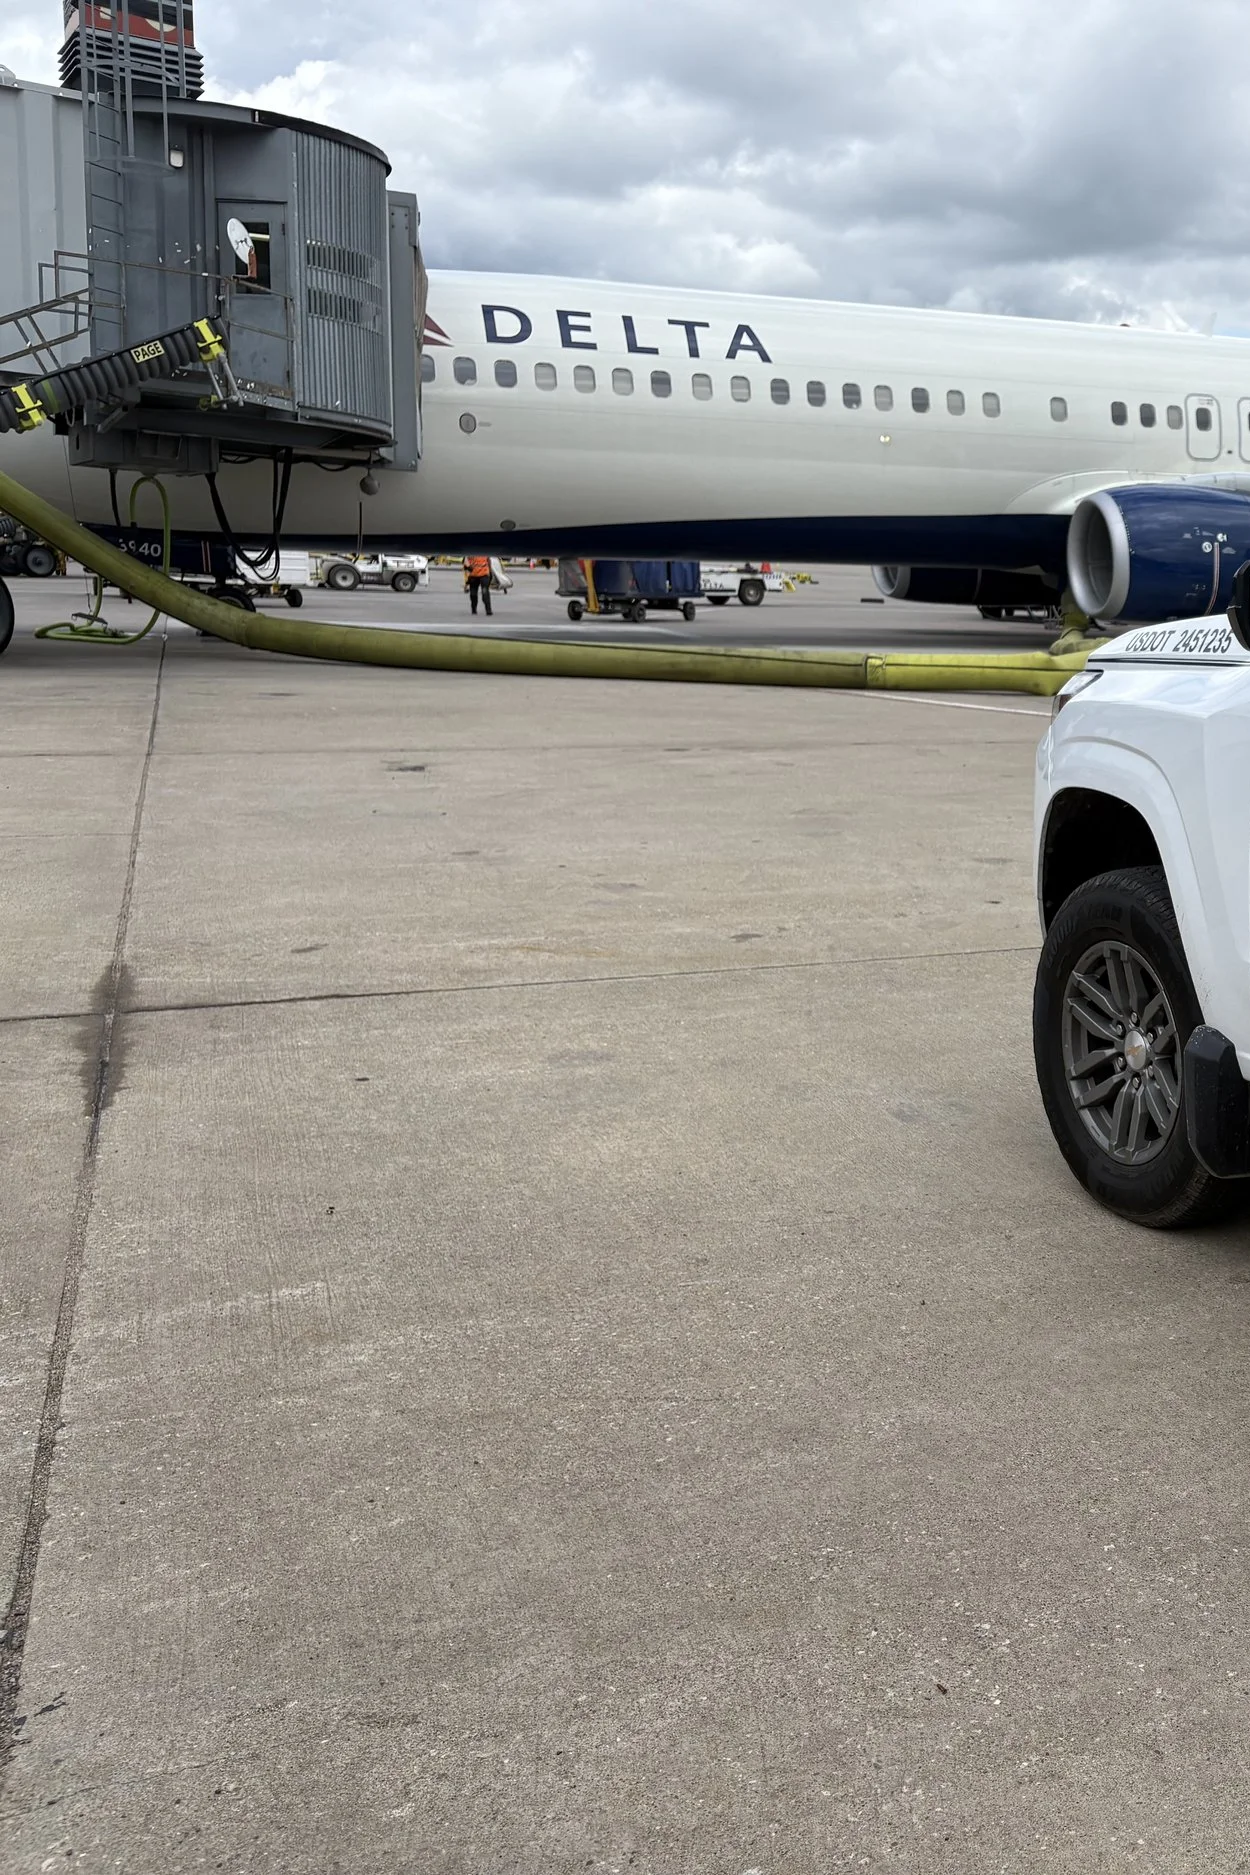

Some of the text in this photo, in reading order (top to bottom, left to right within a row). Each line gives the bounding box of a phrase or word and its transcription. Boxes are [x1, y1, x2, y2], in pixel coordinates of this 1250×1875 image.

[481, 304, 772, 363] DELTA
[133, 342, 162, 361] PAGE
[1125, 628, 1232, 653] USDOT 2451235
